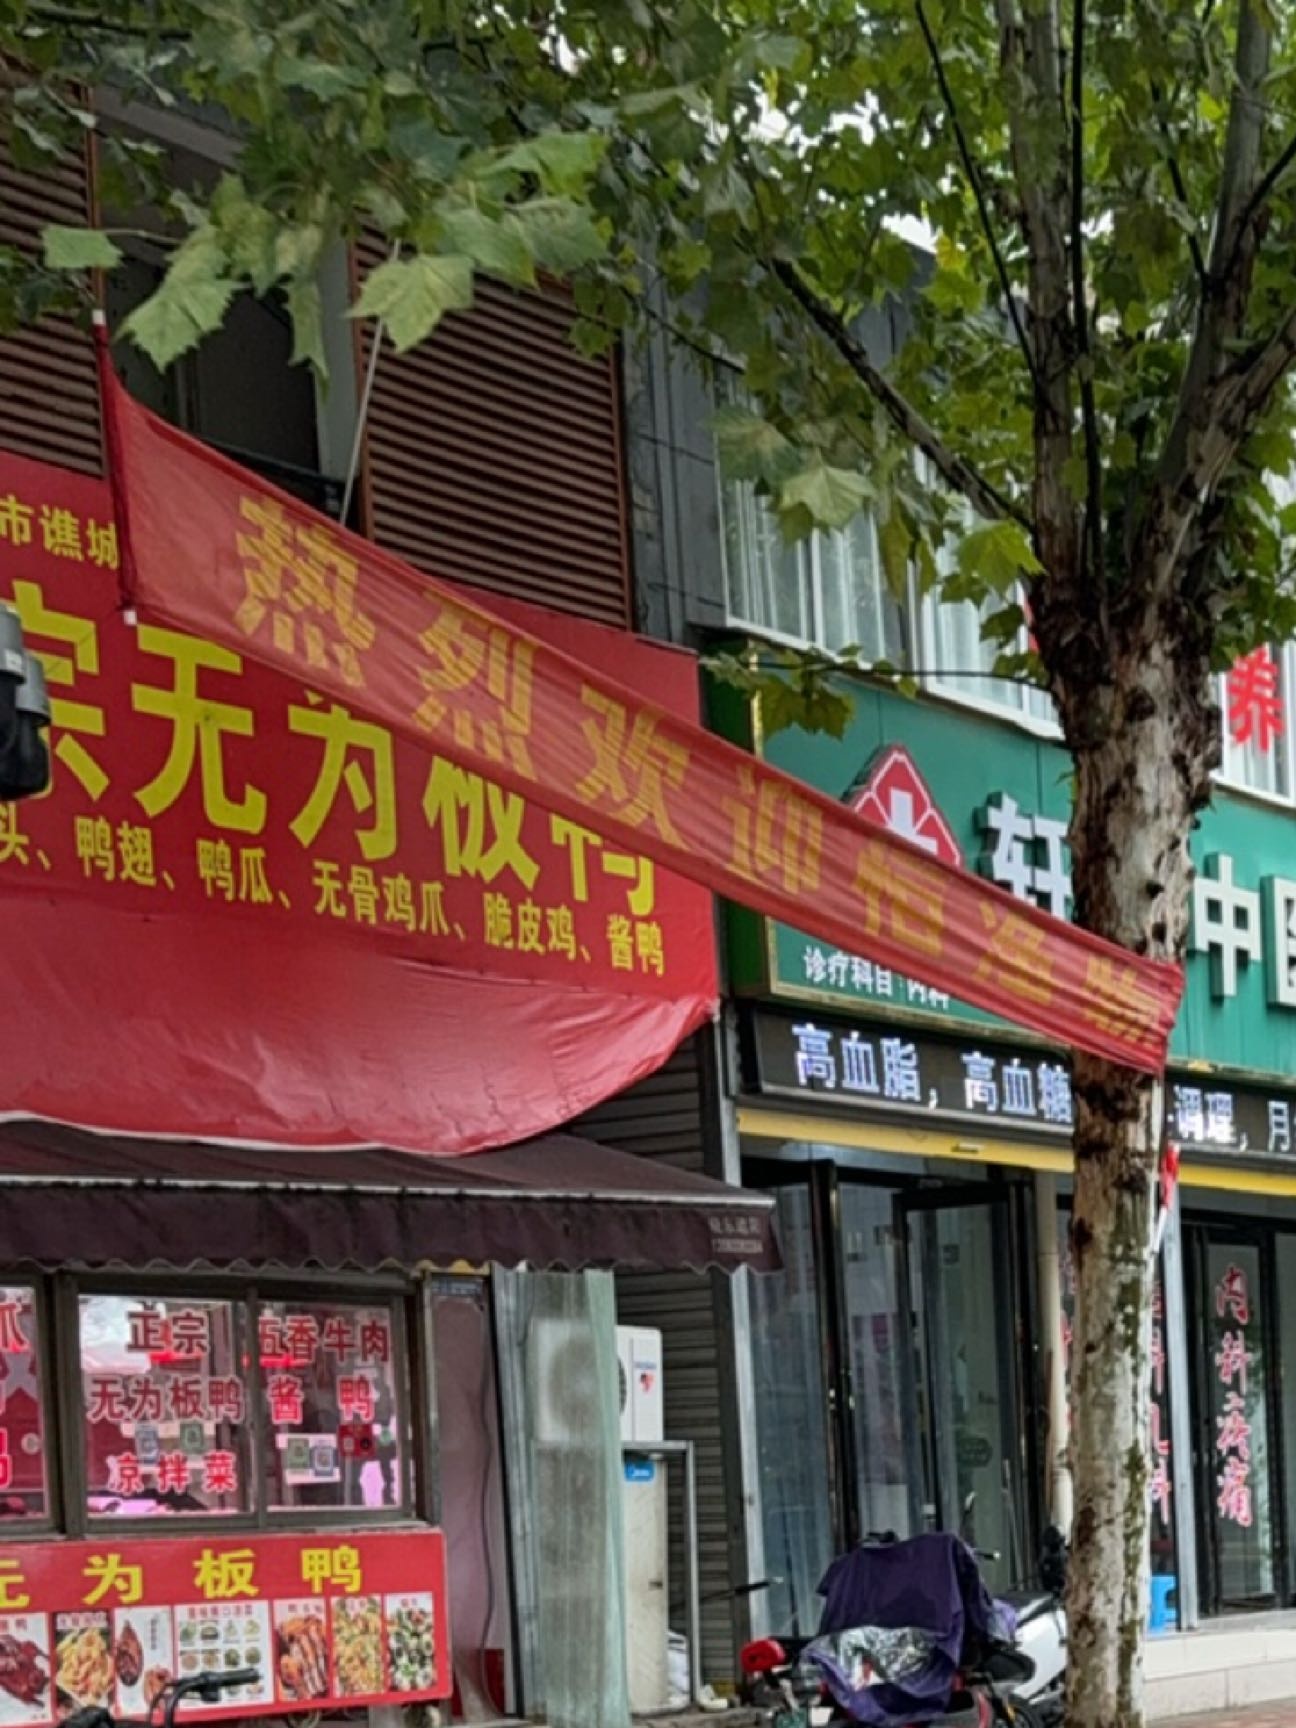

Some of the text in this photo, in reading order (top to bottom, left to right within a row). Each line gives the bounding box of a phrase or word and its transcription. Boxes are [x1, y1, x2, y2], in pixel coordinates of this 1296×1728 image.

[125, 1308, 211, 1356] 正宗
[258, 1313, 391, 1363] 五香牛肉
[86, 1377, 247, 1424] 无为板鸭
[1215, 1263, 1253, 1528] 内科疼痛
